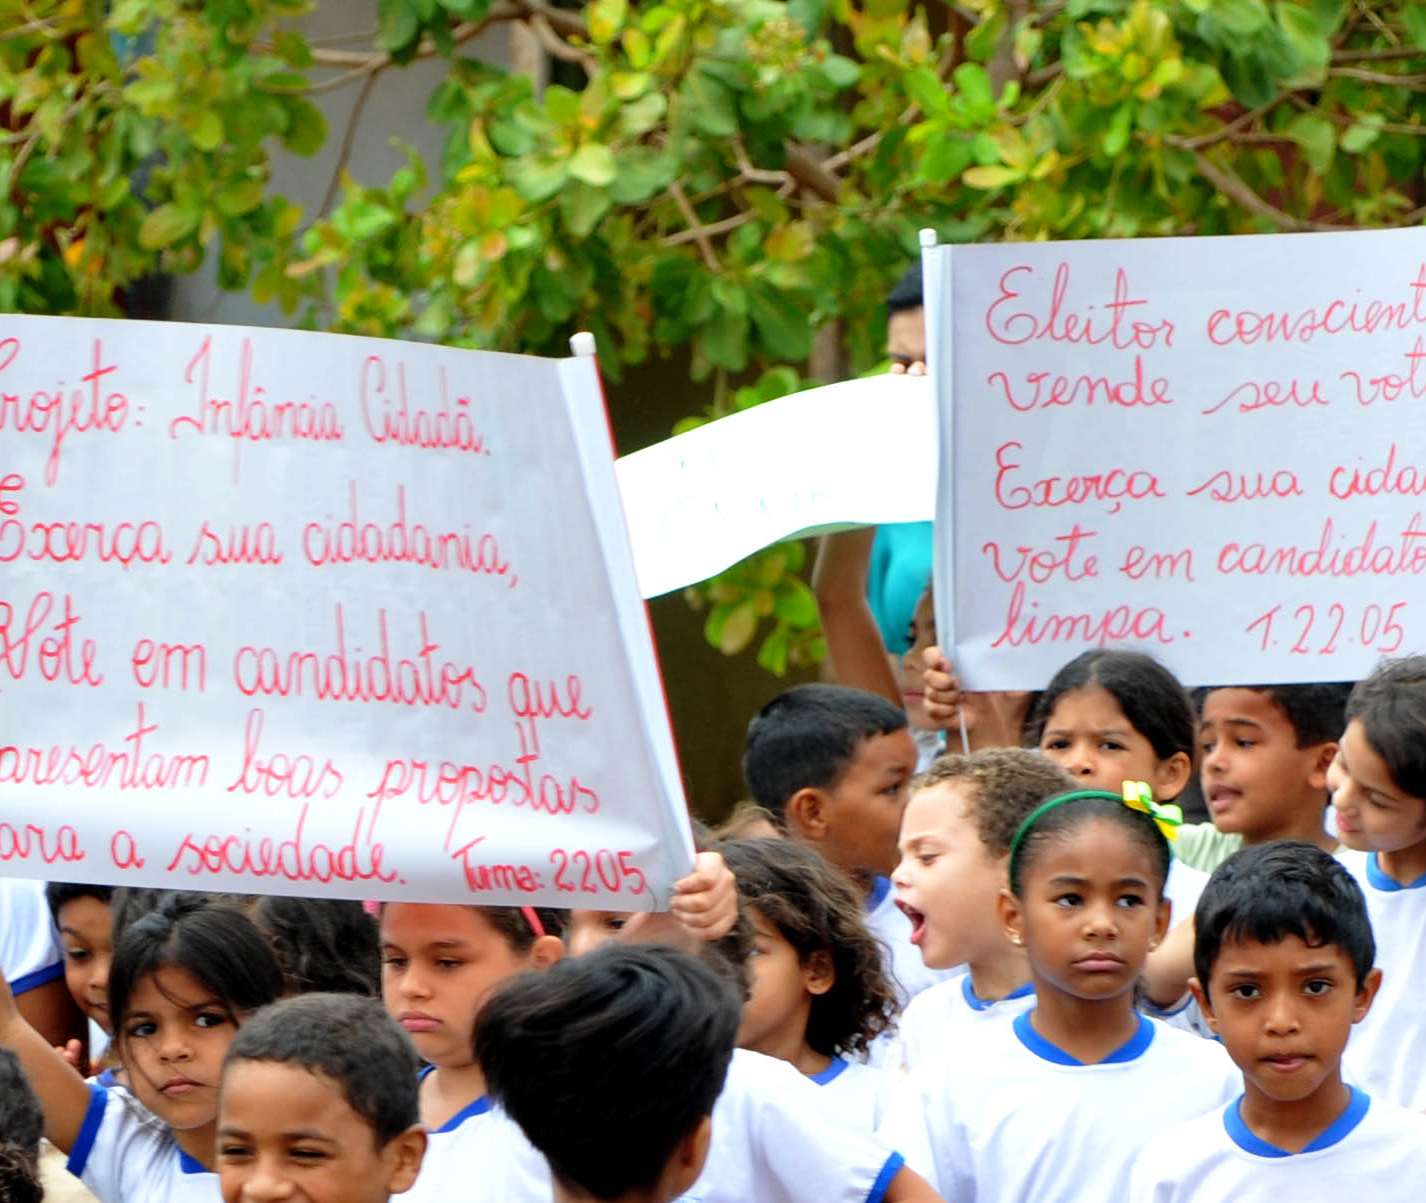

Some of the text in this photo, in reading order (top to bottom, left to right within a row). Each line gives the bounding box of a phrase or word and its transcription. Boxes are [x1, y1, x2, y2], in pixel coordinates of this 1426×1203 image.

[985, 262, 1174, 350] Eleitor
[170, 336, 345, 484] Infância
[359, 355, 491, 456] Cidadã.
[1202, 378, 1330, 416] seu
[994, 441, 1166, 514] Exerça
[1188, 472, 1304, 504] sua
[187, 520, 284, 567] sua
[302, 480, 519, 588] cidadania,
[1119, 547, 1194, 582] em
[991, 580, 1192, 649] limpa.
[131, 638, 207, 692] em
[234, 603, 487, 716] candidatos
[508, 670, 594, 755] que
[226, 709, 343, 800] boas
[366, 722, 602, 854] propostas
[110, 829, 146, 871] a
[166, 800, 407, 886] sociedade.
[549, 848, 647, 896] 2205
